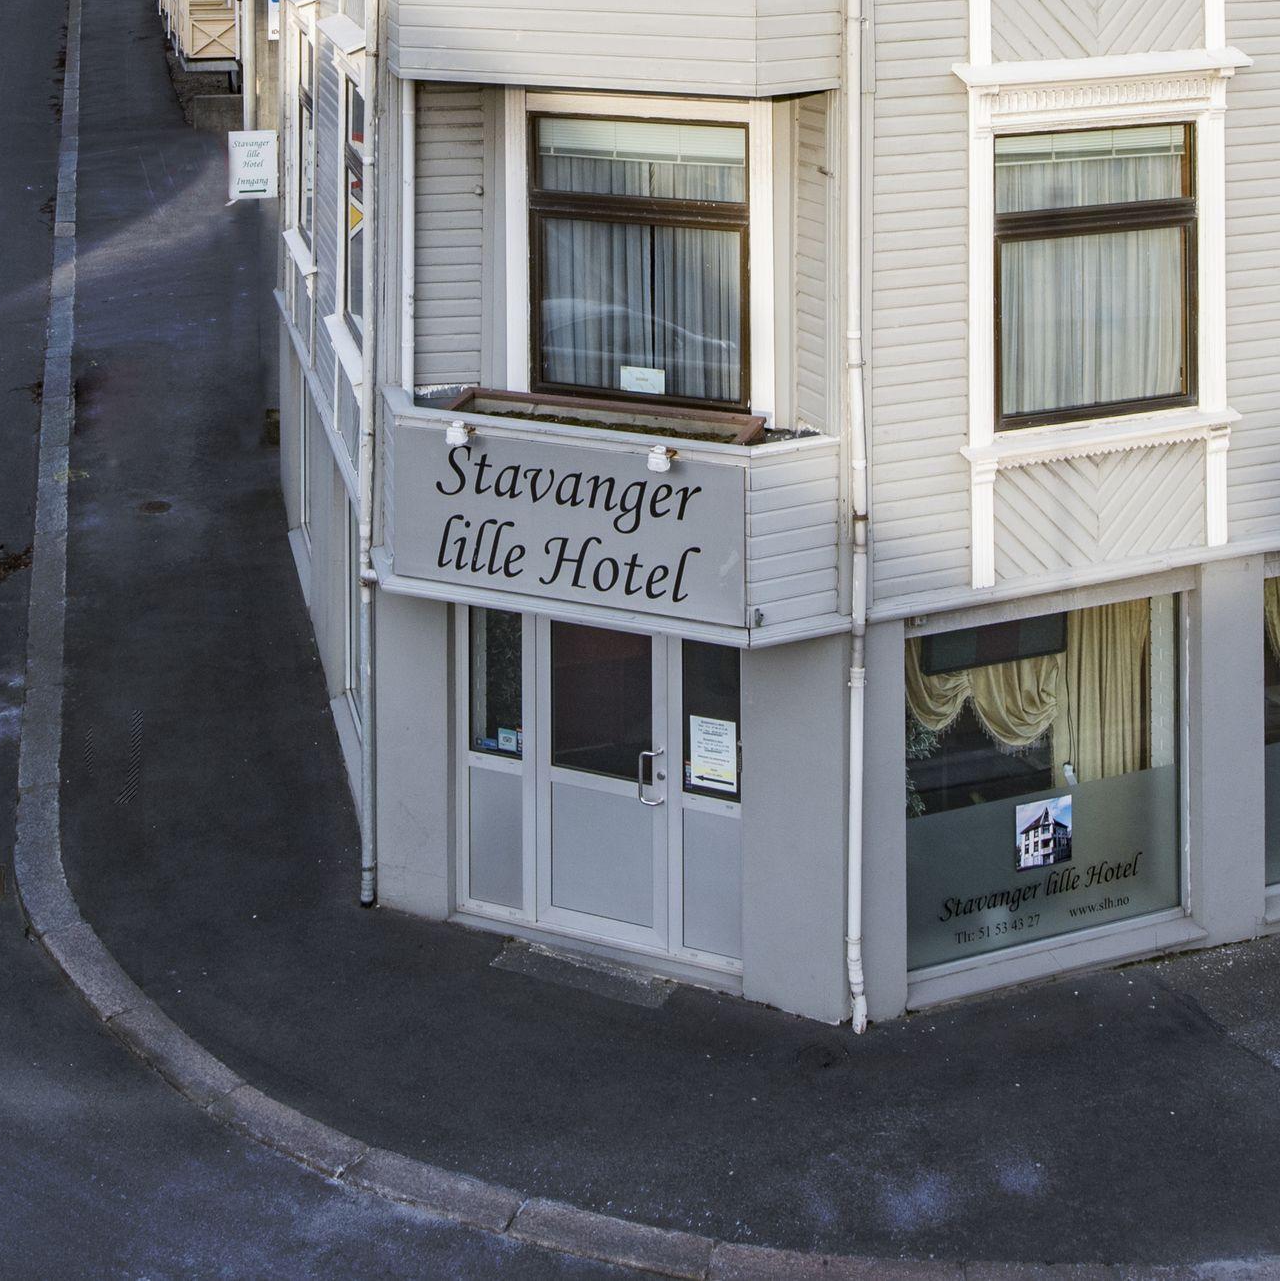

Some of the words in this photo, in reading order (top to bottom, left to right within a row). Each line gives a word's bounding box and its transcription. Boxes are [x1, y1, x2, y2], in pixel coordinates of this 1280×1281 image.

[232, 140, 270, 149] Stavanger
[246, 150, 261, 158] lille
[243, 159, 264, 168] Hotel
[237, 178, 269, 187] Inngang
[436, 446, 702, 533] Stavanger
[437, 515, 526, 578] lille
[539, 536, 700, 602] Hotel
[940, 879, 1042, 922] Stavanger
[1046, 867, 1080, 896] lille
[1085, 852, 1143, 888] Hotel
[1069, 895, 1130, 918] www.slh.no
[978, 925, 991, 939] 51
[994, 921, 1008, 935] 53
[1011, 917, 1024, 930] 43
[1028, 914, 1040, 927] 27
